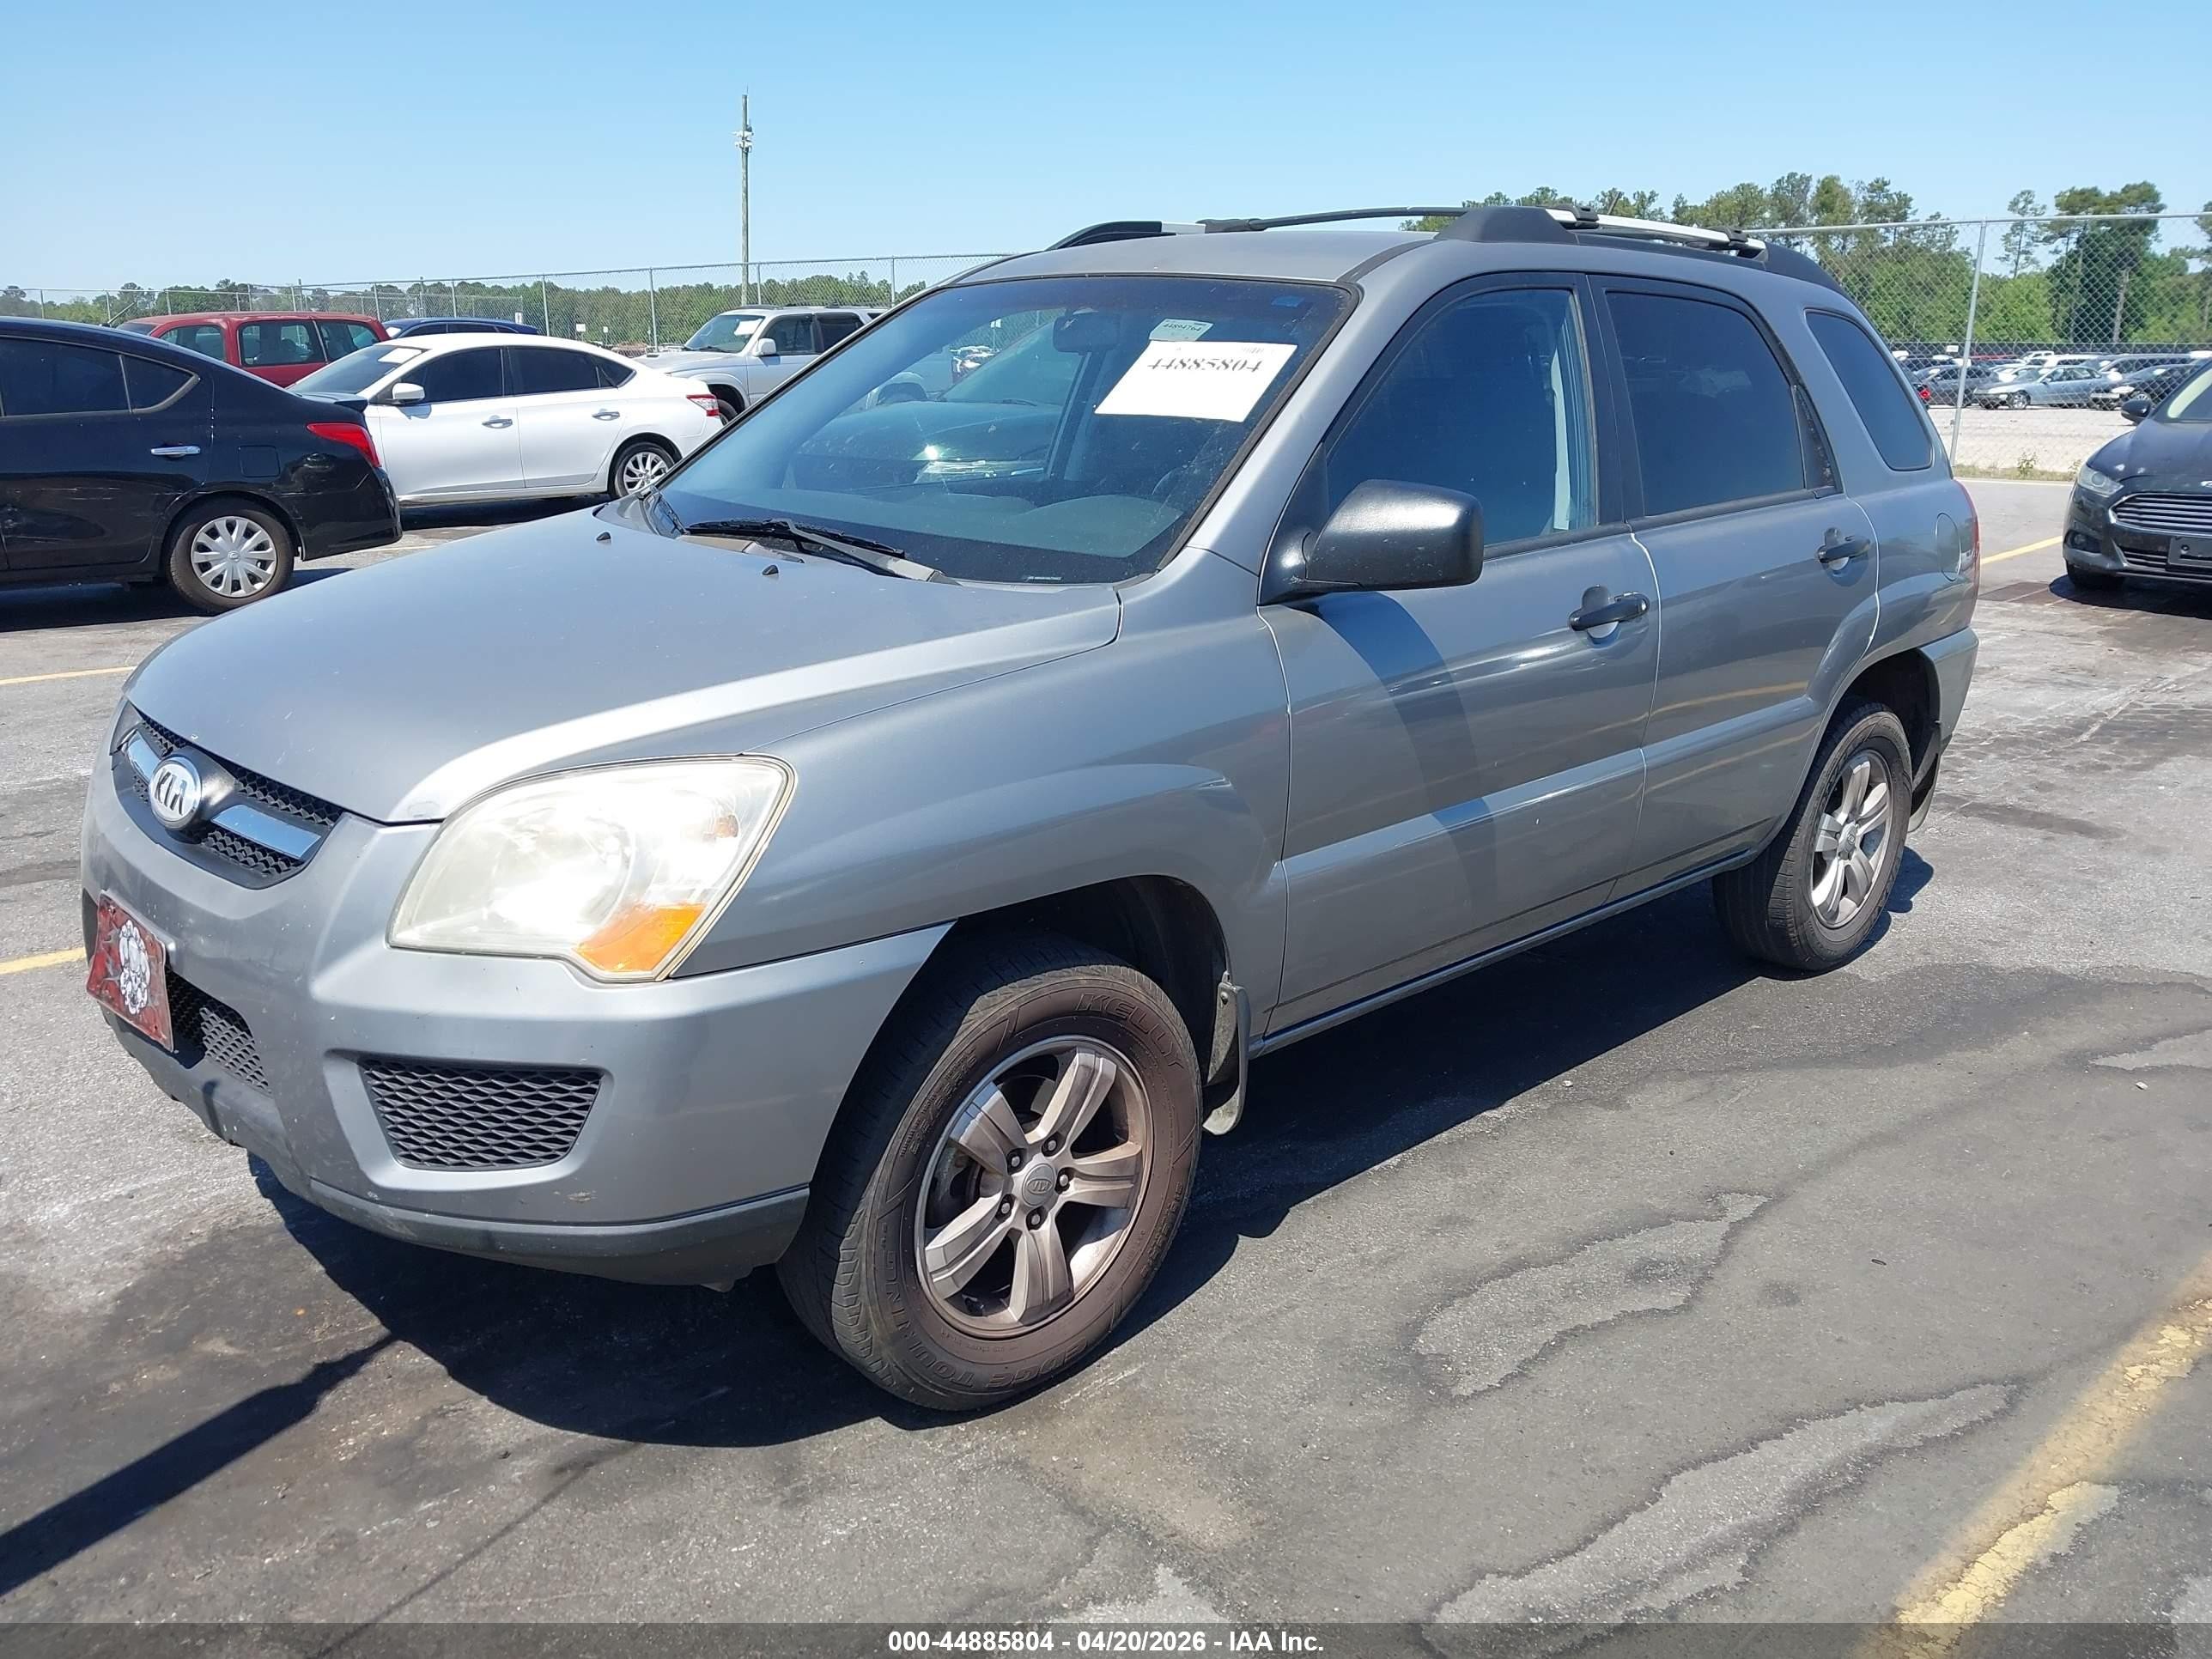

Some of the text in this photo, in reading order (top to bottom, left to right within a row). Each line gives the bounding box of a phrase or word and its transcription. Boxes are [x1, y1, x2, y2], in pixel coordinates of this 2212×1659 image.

[1147, 358, 1262, 372] 44885804
[154, 769, 187, 816] KIA
[1075, 993, 1184, 1070] KELLY
